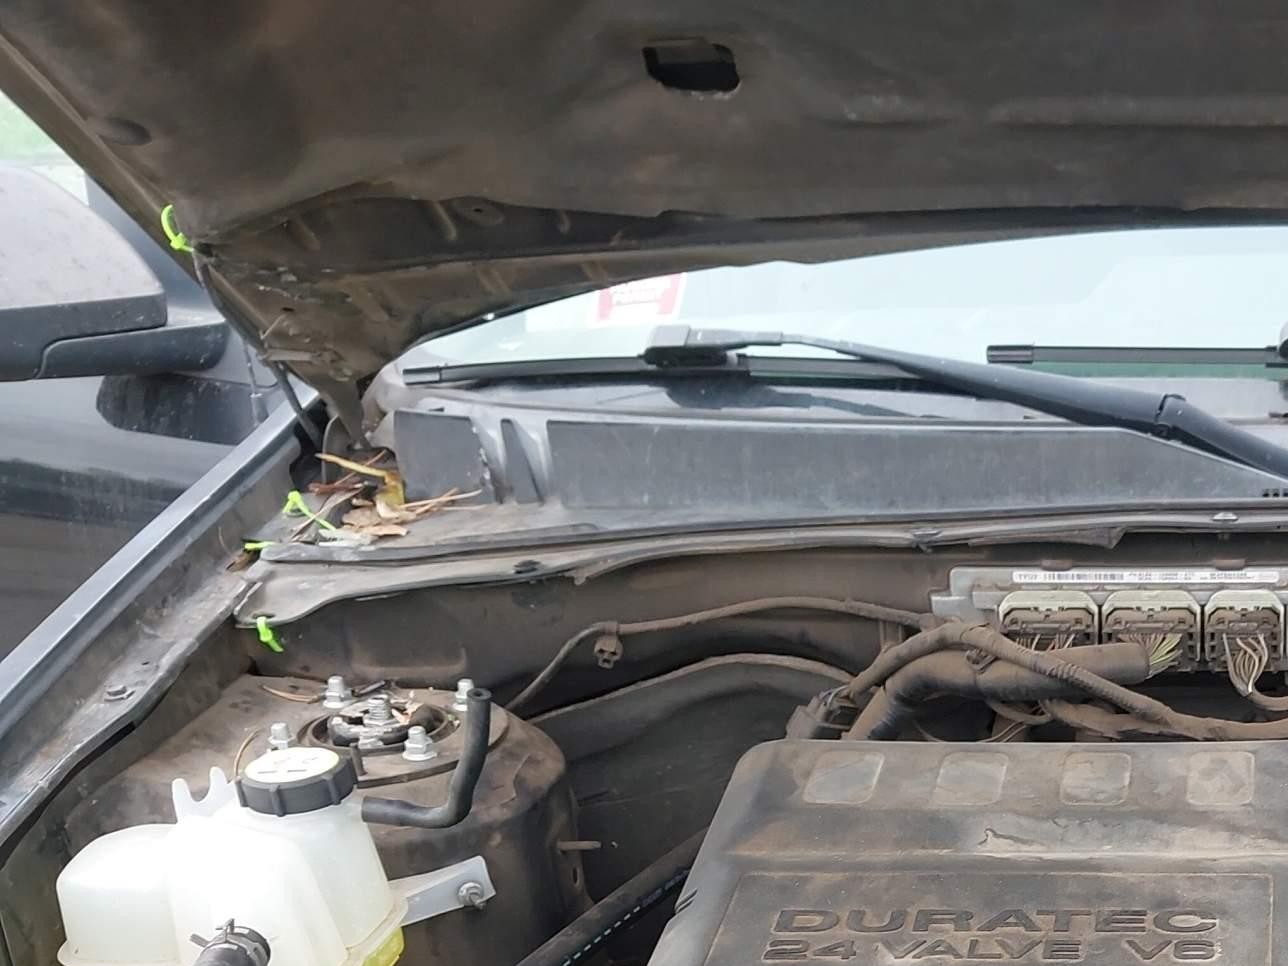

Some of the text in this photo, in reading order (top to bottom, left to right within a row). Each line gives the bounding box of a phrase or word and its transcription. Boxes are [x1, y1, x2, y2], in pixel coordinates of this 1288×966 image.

[771, 909, 1218, 934] DURATEC
[762, 938, 1218, 962] 24 VALVE V6
